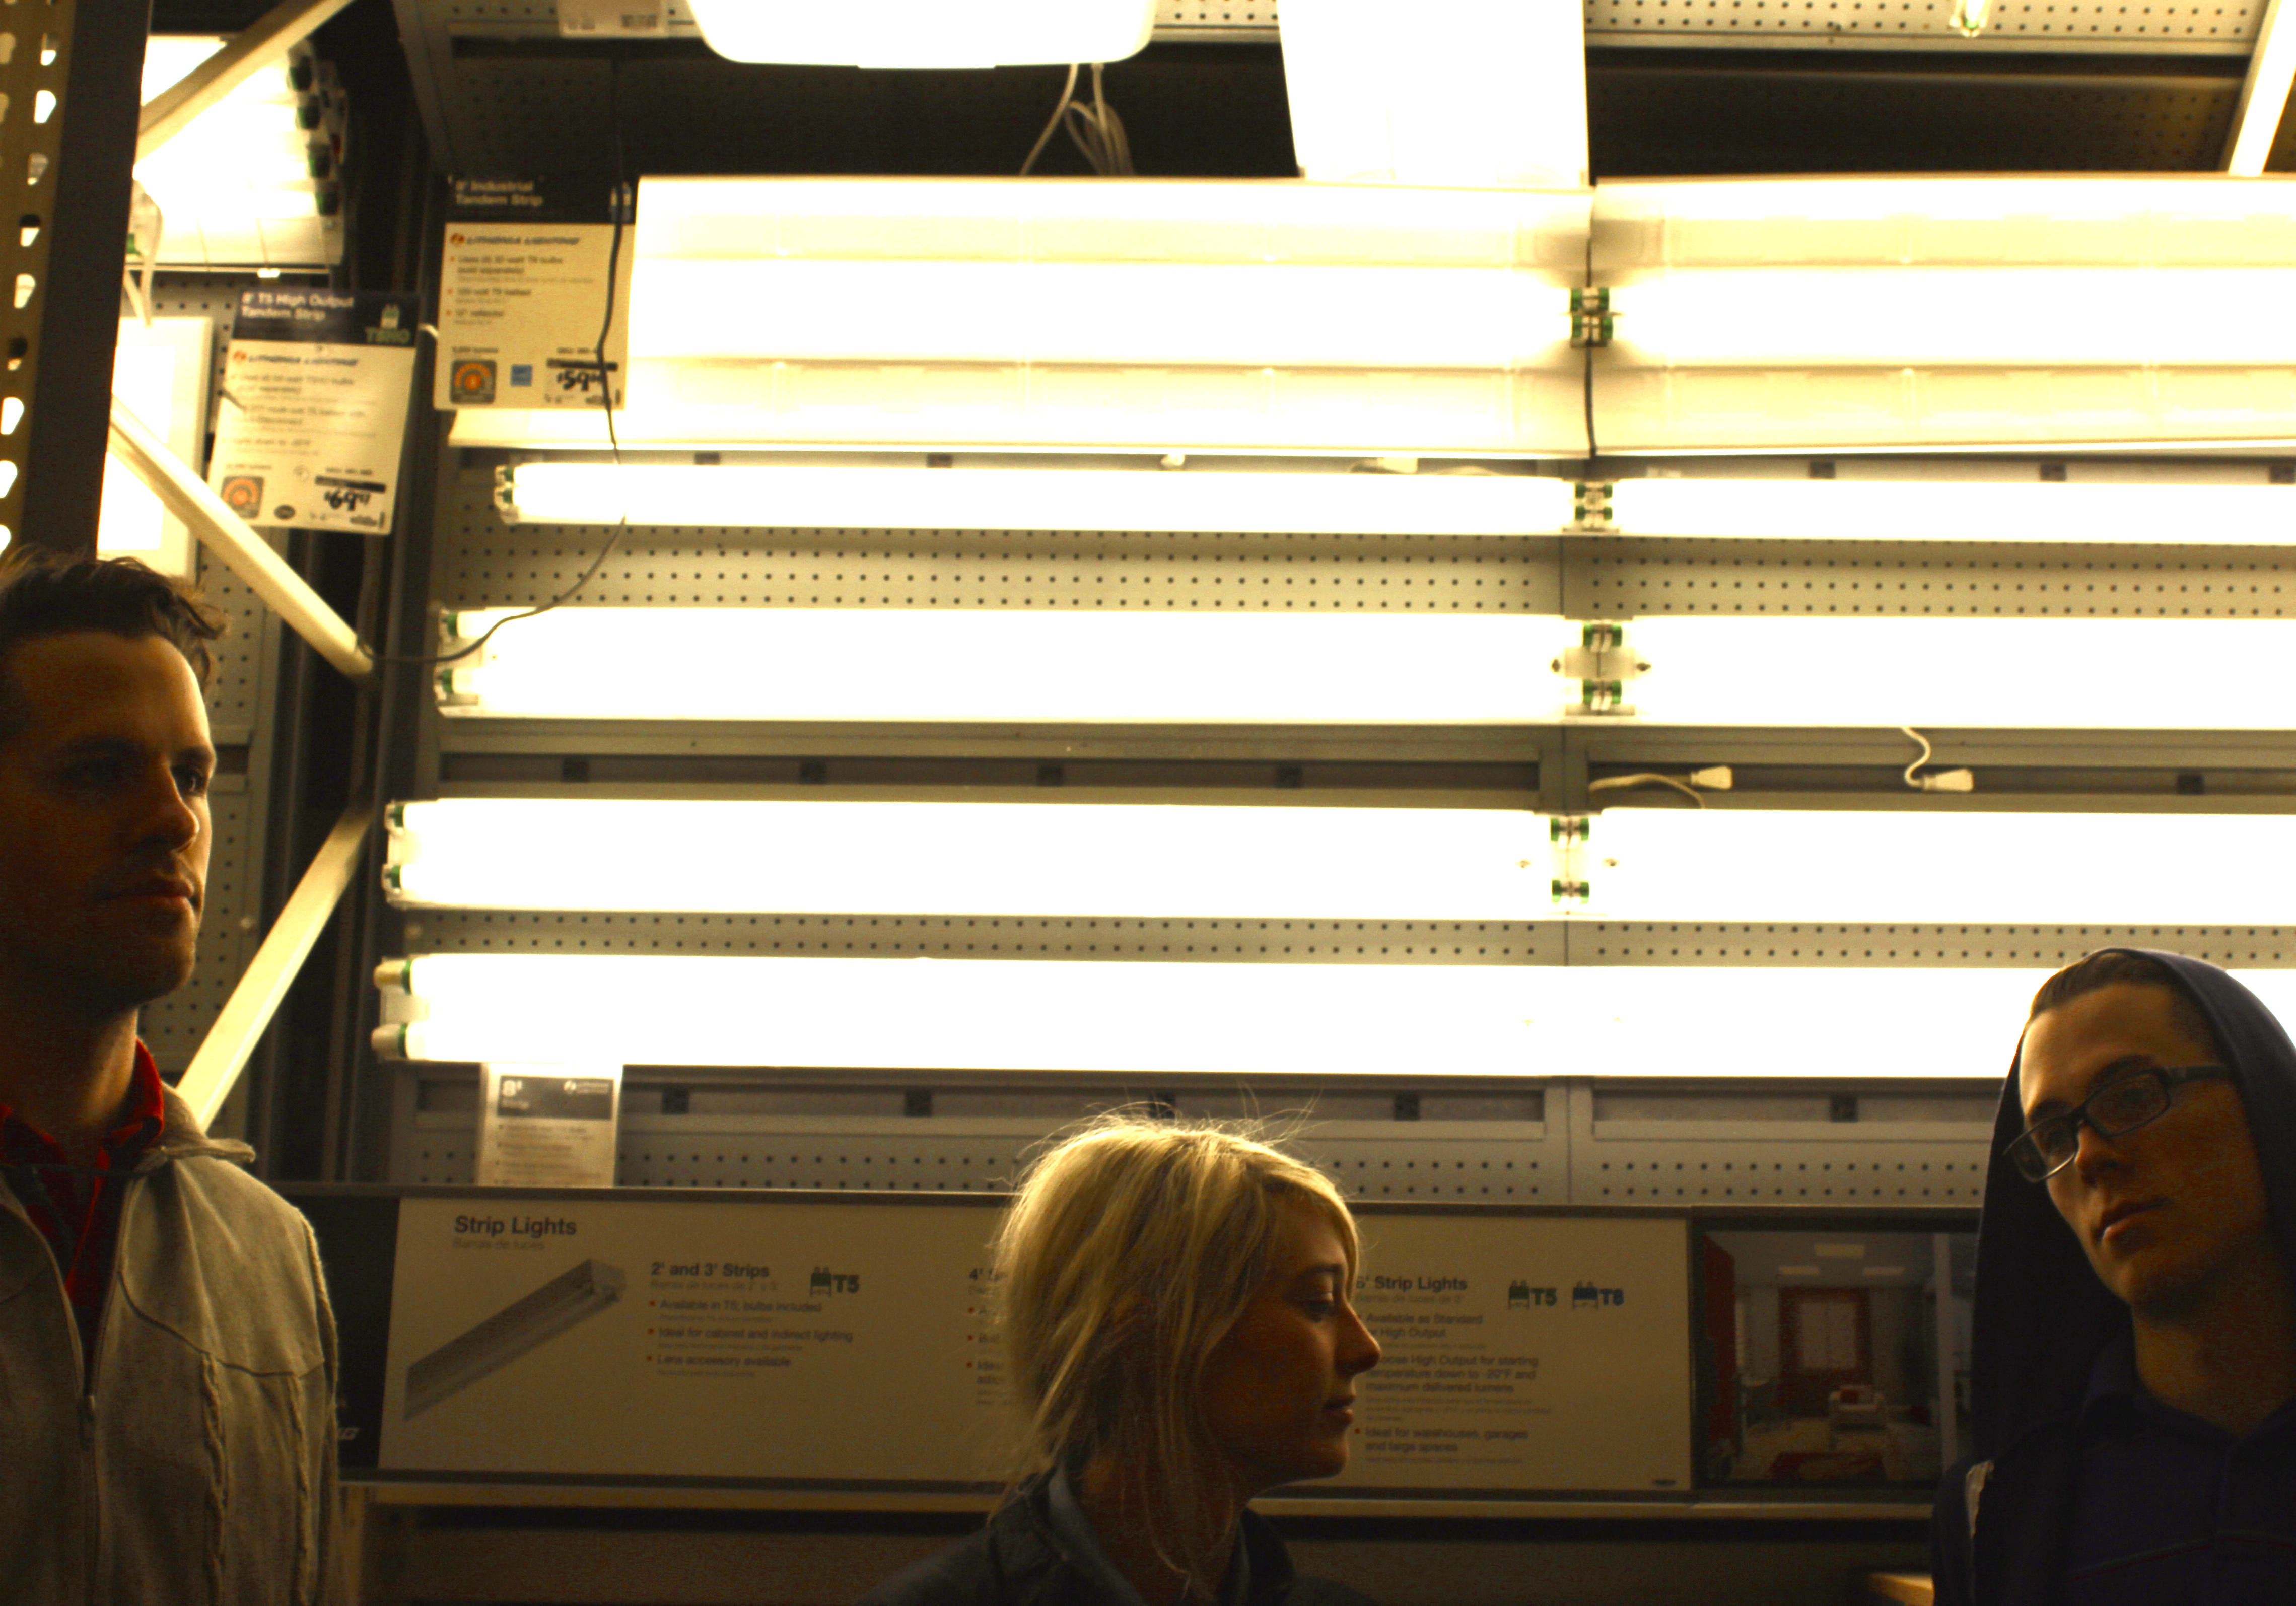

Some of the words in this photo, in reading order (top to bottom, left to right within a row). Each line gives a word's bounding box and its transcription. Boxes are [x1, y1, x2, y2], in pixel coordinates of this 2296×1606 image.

[510, 194, 543, 206] Strip
[276, 293, 306, 306] High
[309, 294, 354, 308] Output
[242, 306, 291, 318] Tandem
[294, 307, 326, 322] Strip
[454, 1215, 504, 1237] Strip
[511, 1216, 577, 1239] Lights
[651, 1262, 665, 1276] 2'
[670, 1263, 700, 1277] and
[705, 1263, 718, 1277] 3'
[723, 1263, 770, 1279] Strips
[832, 1274, 860, 1293] T5
[1375, 1275, 1413, 1293] Strip
[1418, 1276, 1468, 1293] Lights
[1530, 1287, 1557, 1306] T5
[1599, 1288, 1625, 1307] T8
[660, 1300, 708, 1310] Available
[743, 1301, 773, 1311] bulbs
[776, 1302, 821, 1312] included
[1367, 1314, 1414, 1323] Available
[1434, 1314, 1484, 1325] Standard
[658, 1328, 684, 1338] Ideal
[687, 1328, 702, 1338] for
[747, 1329, 769, 1339] and
[812, 1330, 853, 1343] lighting
[1380, 1329, 1405, 1339] High
[1410, 1328, 1447, 1339] Output
[743, 1356, 791, 1367] available
[1411, 1355, 1436, 1367] High
[1439, 1356, 1477, 1366] Output
[1480, 1356, 1495, 1365] for
[1434, 1370, 1465, 1380] down
[1467, 1371, 1479, 1380] to
[1515, 1371, 1536, 1380] and
[1365, 1428, 1393, 1438] Ideal
[1395, 1428, 1410, 1438] for
[1484, 1431, 1528, 1441] garages
[1365, 1443, 1386, 1452] and
